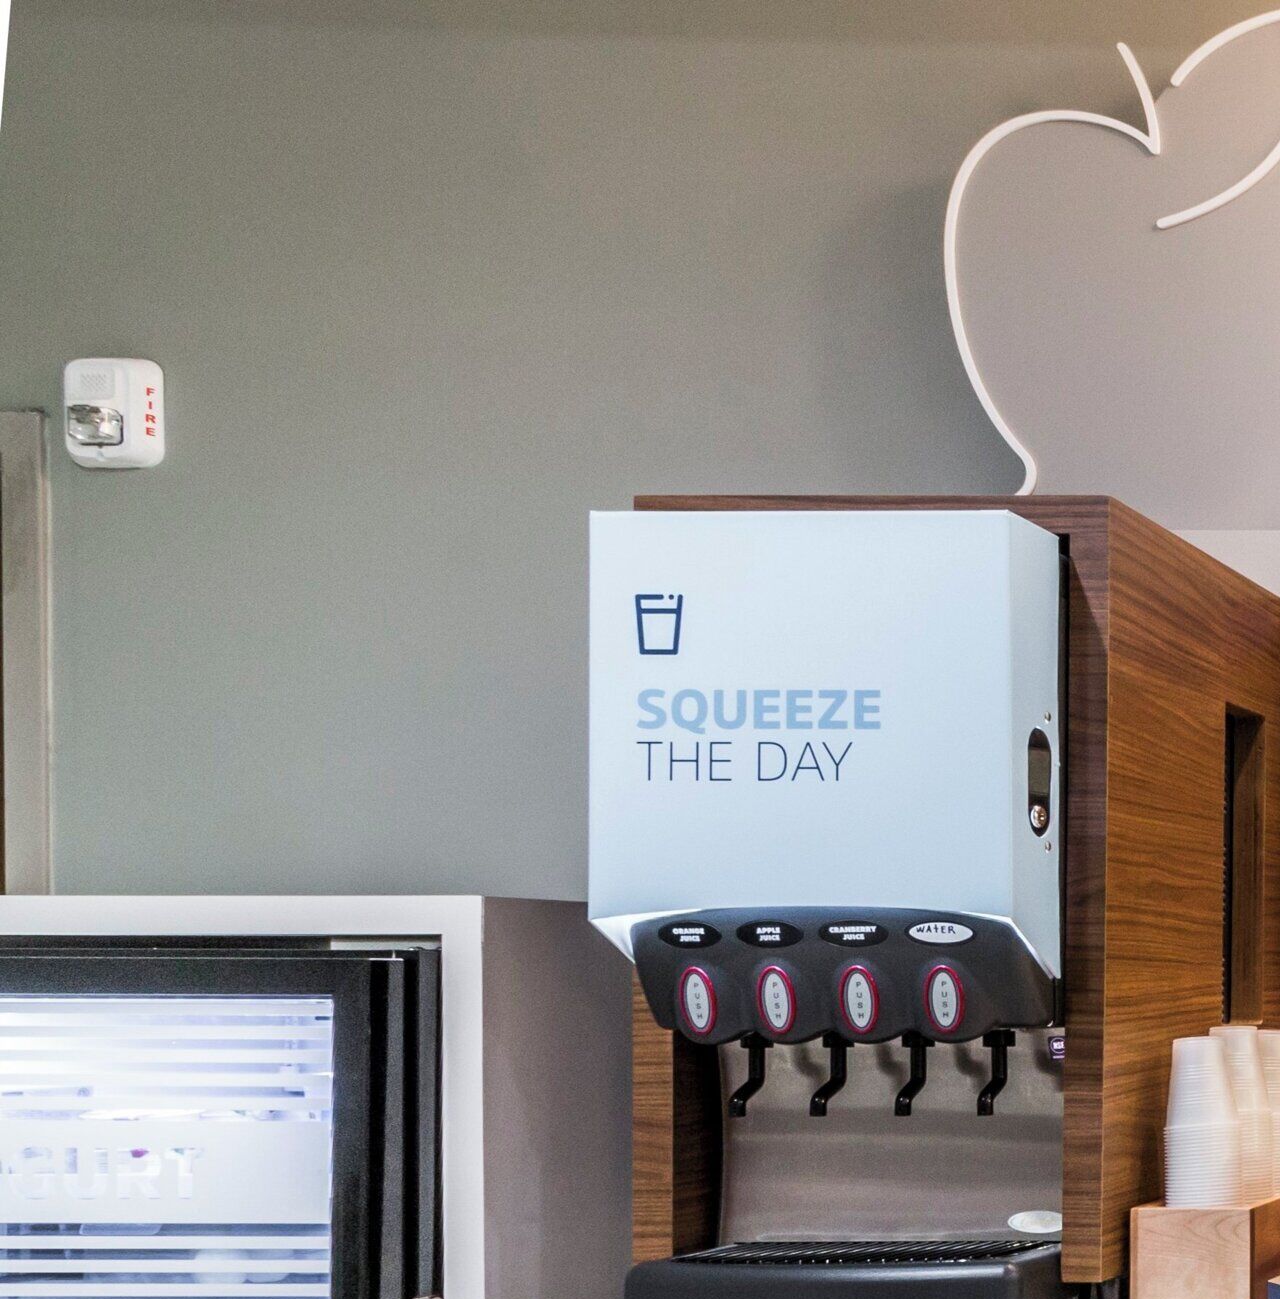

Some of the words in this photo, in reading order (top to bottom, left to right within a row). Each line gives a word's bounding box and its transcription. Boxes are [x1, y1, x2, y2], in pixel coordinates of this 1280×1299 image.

[145, 387, 156, 437] FIRE
[636, 688, 882, 735] SQUEEZE
[636, 741, 732, 782] THE
[757, 741, 853, 782] DAY
[756, 926, 781, 935] APPLE
[759, 934, 781, 942] JUICE
[828, 925, 877, 934] CRANBERRY
[842, 933, 865, 941] JUICE
[693, 982, 703, 1020] PUSH
[772, 981, 782, 1020] PUSH
[855, 981, 865, 1019] PUSH
[940, 980, 949, 1018] PUSH
[0, 1147, 202, 1200] GURT
